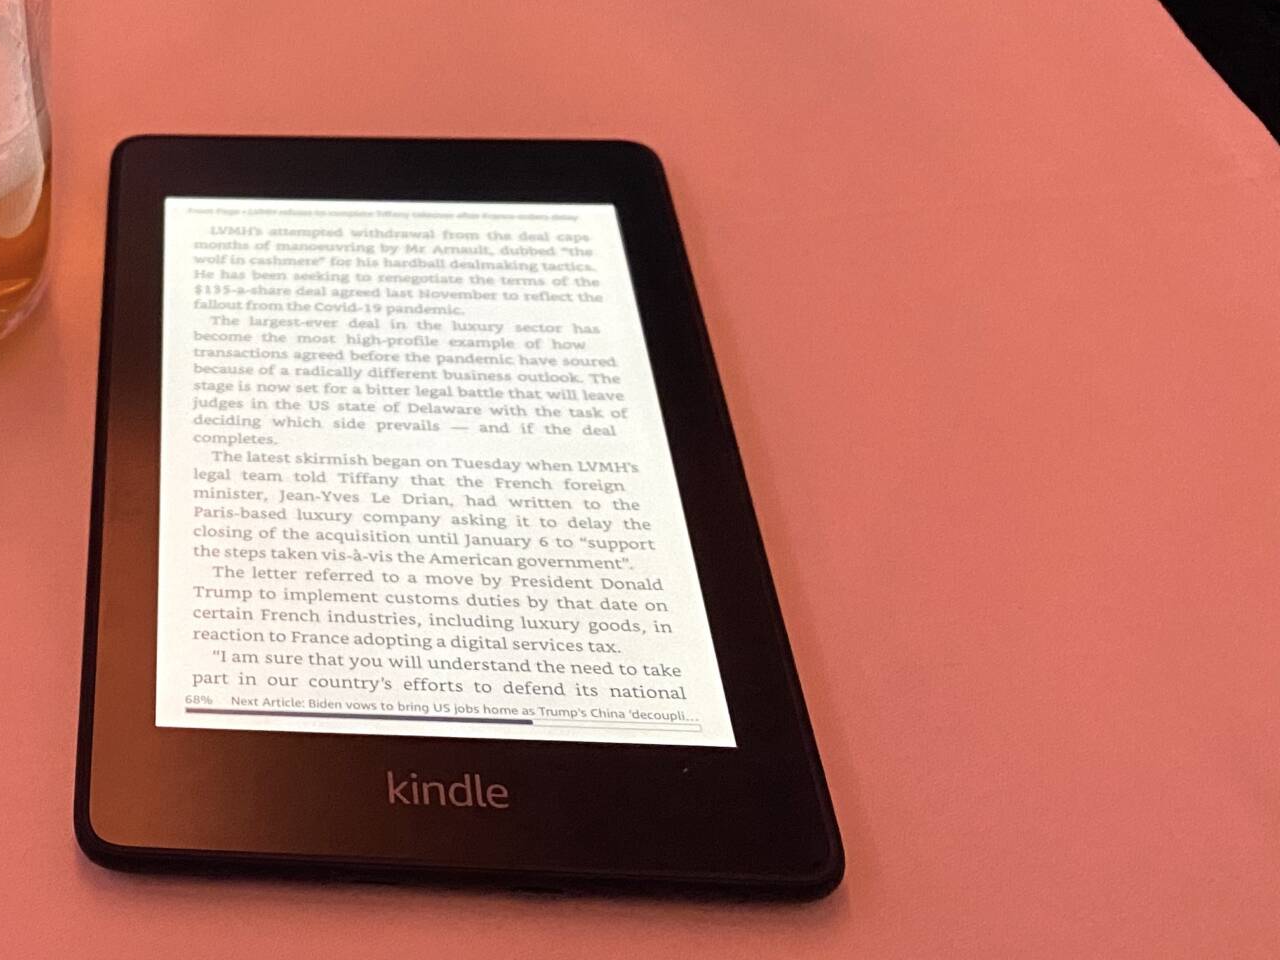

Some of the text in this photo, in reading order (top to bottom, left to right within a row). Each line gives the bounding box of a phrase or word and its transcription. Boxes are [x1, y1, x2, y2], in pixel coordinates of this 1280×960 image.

[193, 298, 465, 316] fallout from the Covid-19 pandemic.
[192, 430, 280, 447] completes.
[211, 449, 242, 463] The
[246, 450, 291, 464] latest
[294, 451, 368, 466] skirmish
[371, 454, 421, 469] began
[425, 458, 448, 468] on
[450, 456, 523, 472] Tuesday
[524, 458, 574, 472] when
[193, 467, 626, 493] legal team told Tiffany that the French foreign
[193, 486, 641, 511] minister, Jean-Yves Le Drian, had written to the
[193, 505, 652, 531] Paris-based luxury company asking it to delay the
[193, 524, 253, 542] closing
[258, 526, 277, 539] of
[282, 527, 309, 540] the
[315, 528, 411, 546] acquisition
[416, 531, 459, 545] until
[464, 533, 533, 549] January
[538, 536, 549, 547] 6
[555, 537, 574, 548] to
[193, 544, 220, 557] the
[224, 547, 266, 562] steps
[270, 546, 317, 560] taken
[320, 547, 393, 563] vis-à-vis
[396, 550, 425, 564] the
[427, 551, 513, 567] American
[211, 564, 664, 591] The letter referred to a move by President Donald
[192, 585, 668, 612] Trump to implement customs duties by that date on
[192, 605, 672, 635] certain French industries, including luxury goods, in
[193, 627, 621, 653] reaction to France adopting a digital services tax.
[231, 653, 258, 663] am
[265, 654, 303, 665] sure
[307, 652, 344, 666] that
[349, 656, 383, 671] you
[387, 654, 422, 669] will
[426, 655, 531, 673] understand
[535, 659, 566, 674] the
[569, 660, 614, 675] need
[618, 664, 638, 676] to
[641, 662, 682, 677] take
[192, 672, 228, 688] part
[238, 672, 256, 686] in
[267, 676, 298, 687] our
[402, 677, 464, 692] efforts
[473, 681, 492, 693] to
[502, 680, 566, 696] defend
[574, 682, 599, 697] its
[608, 683, 687, 700] national
[184, 694, 213, 705] 68%
[231, 696, 258, 707] Next
[261, 696, 304, 708] Article:
[308, 697, 342, 709] Biden
[345, 702, 377, 710] vows
[380, 702, 394, 711] to
[397, 701, 429, 713] bring
[433, 703, 451, 713] US
[453, 703, 480, 715] jobs
[482, 703, 519, 715] home
[521, 707, 536, 716] as
[589, 707, 626, 719] China
[386, 770, 510, 809] kindle
